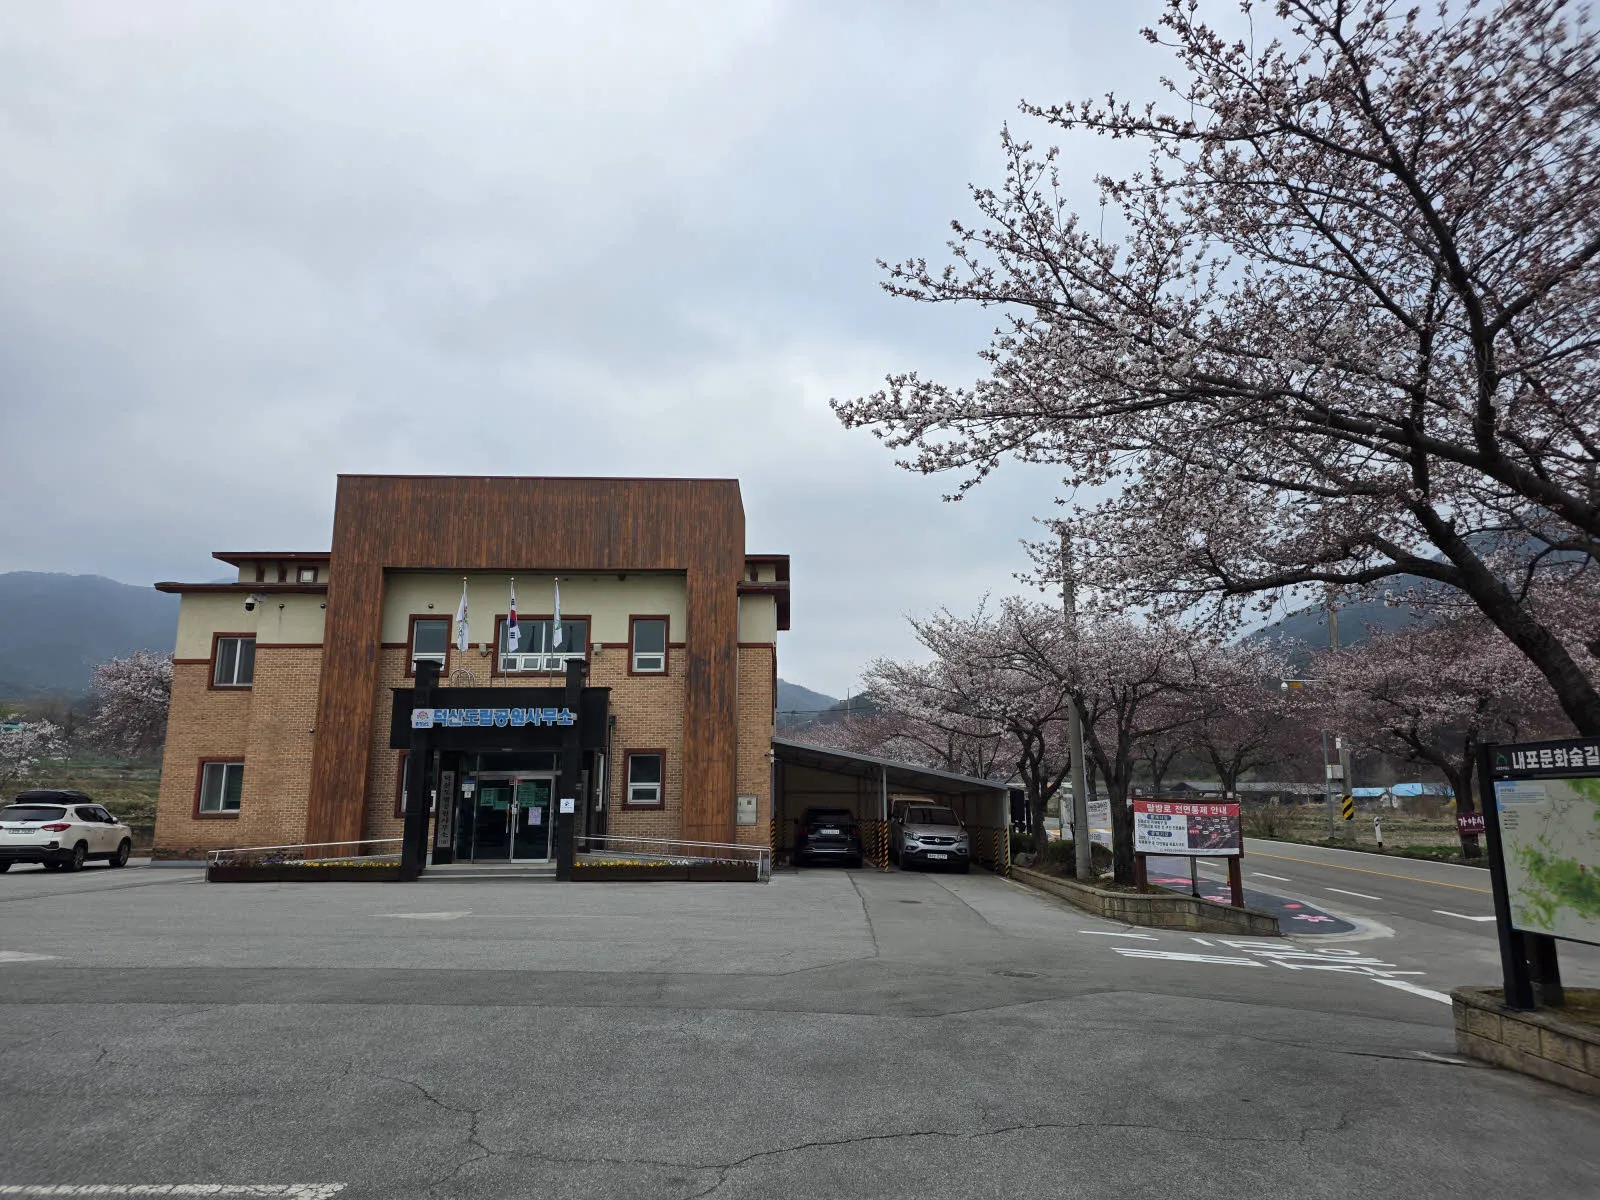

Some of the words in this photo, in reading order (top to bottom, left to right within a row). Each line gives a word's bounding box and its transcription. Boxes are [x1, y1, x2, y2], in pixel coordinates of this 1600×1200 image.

[433, 708, 574, 727] 덕산도립공원사무소
[1511, 746, 1600, 769] 내포문화숲길
[1175, 805, 1207, 815] 전면통제
[1210, 806, 1227, 815] 안내
